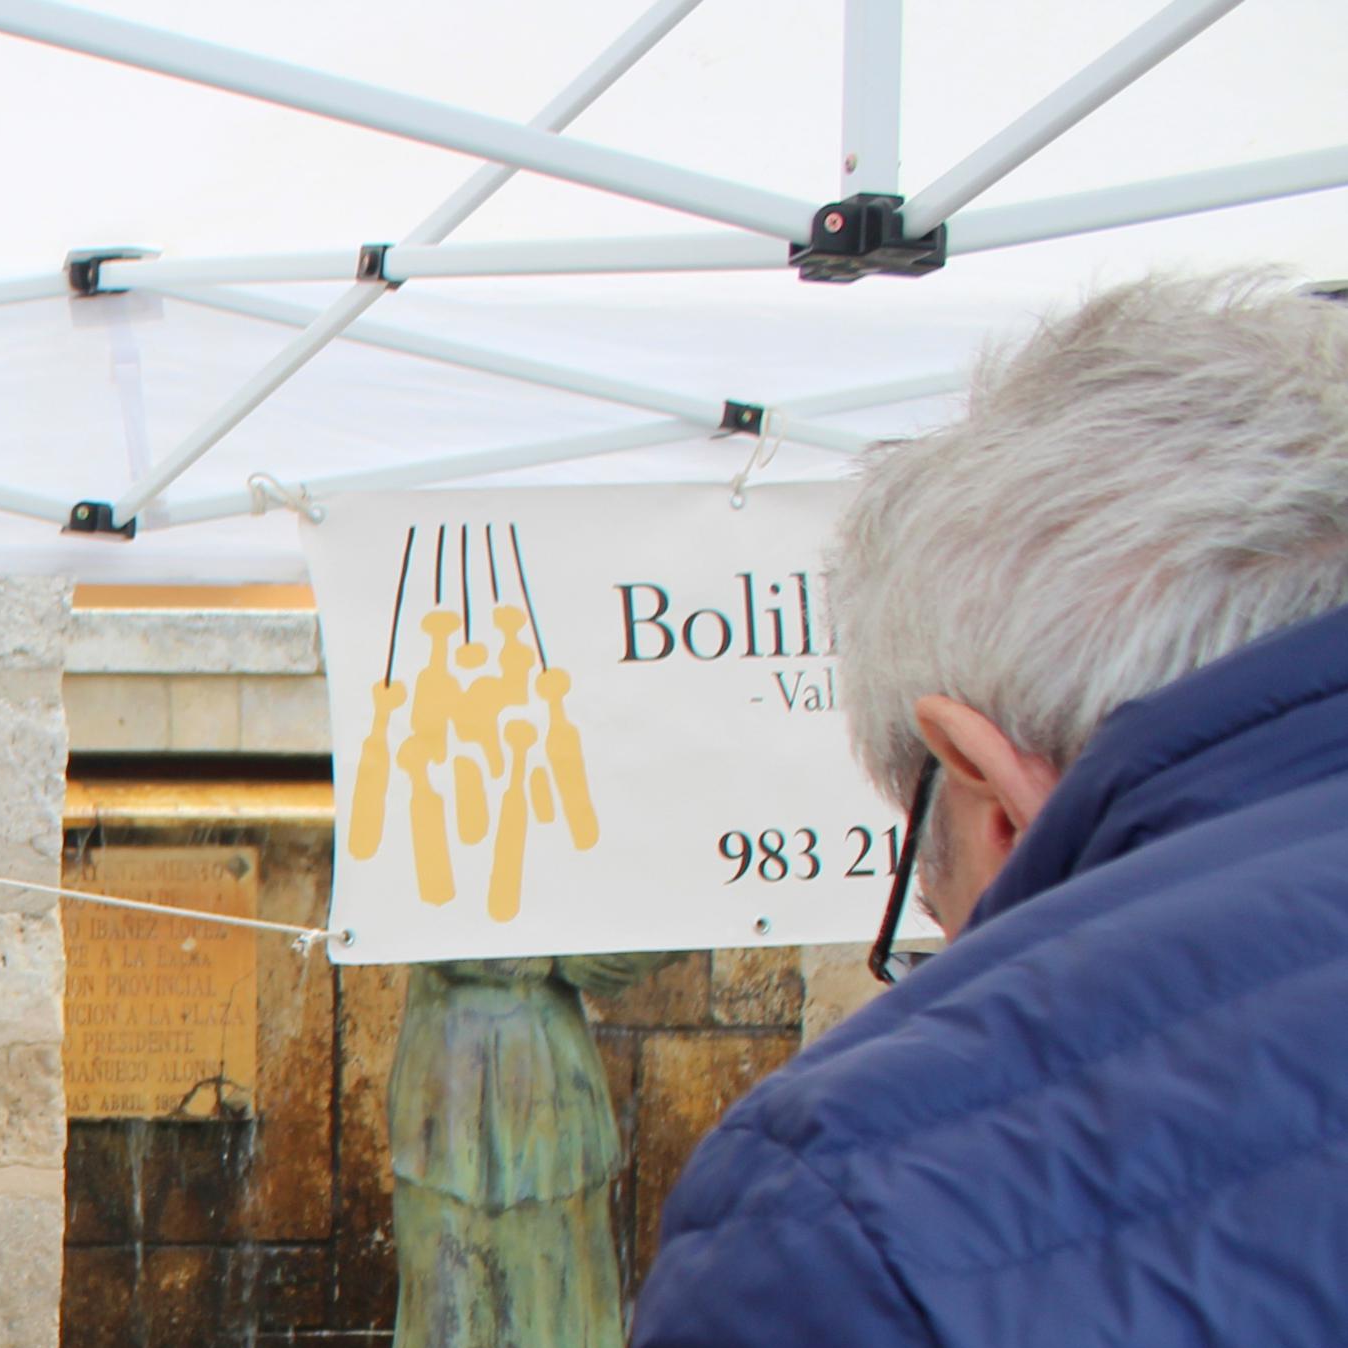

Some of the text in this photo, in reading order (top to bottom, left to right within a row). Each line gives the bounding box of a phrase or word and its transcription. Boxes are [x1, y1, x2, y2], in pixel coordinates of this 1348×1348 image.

[718, 826, 822, 885] 983
[105, 974, 217, 998] PROVINCIAL
[82, 1031, 196, 1054] PRESIDENTE
